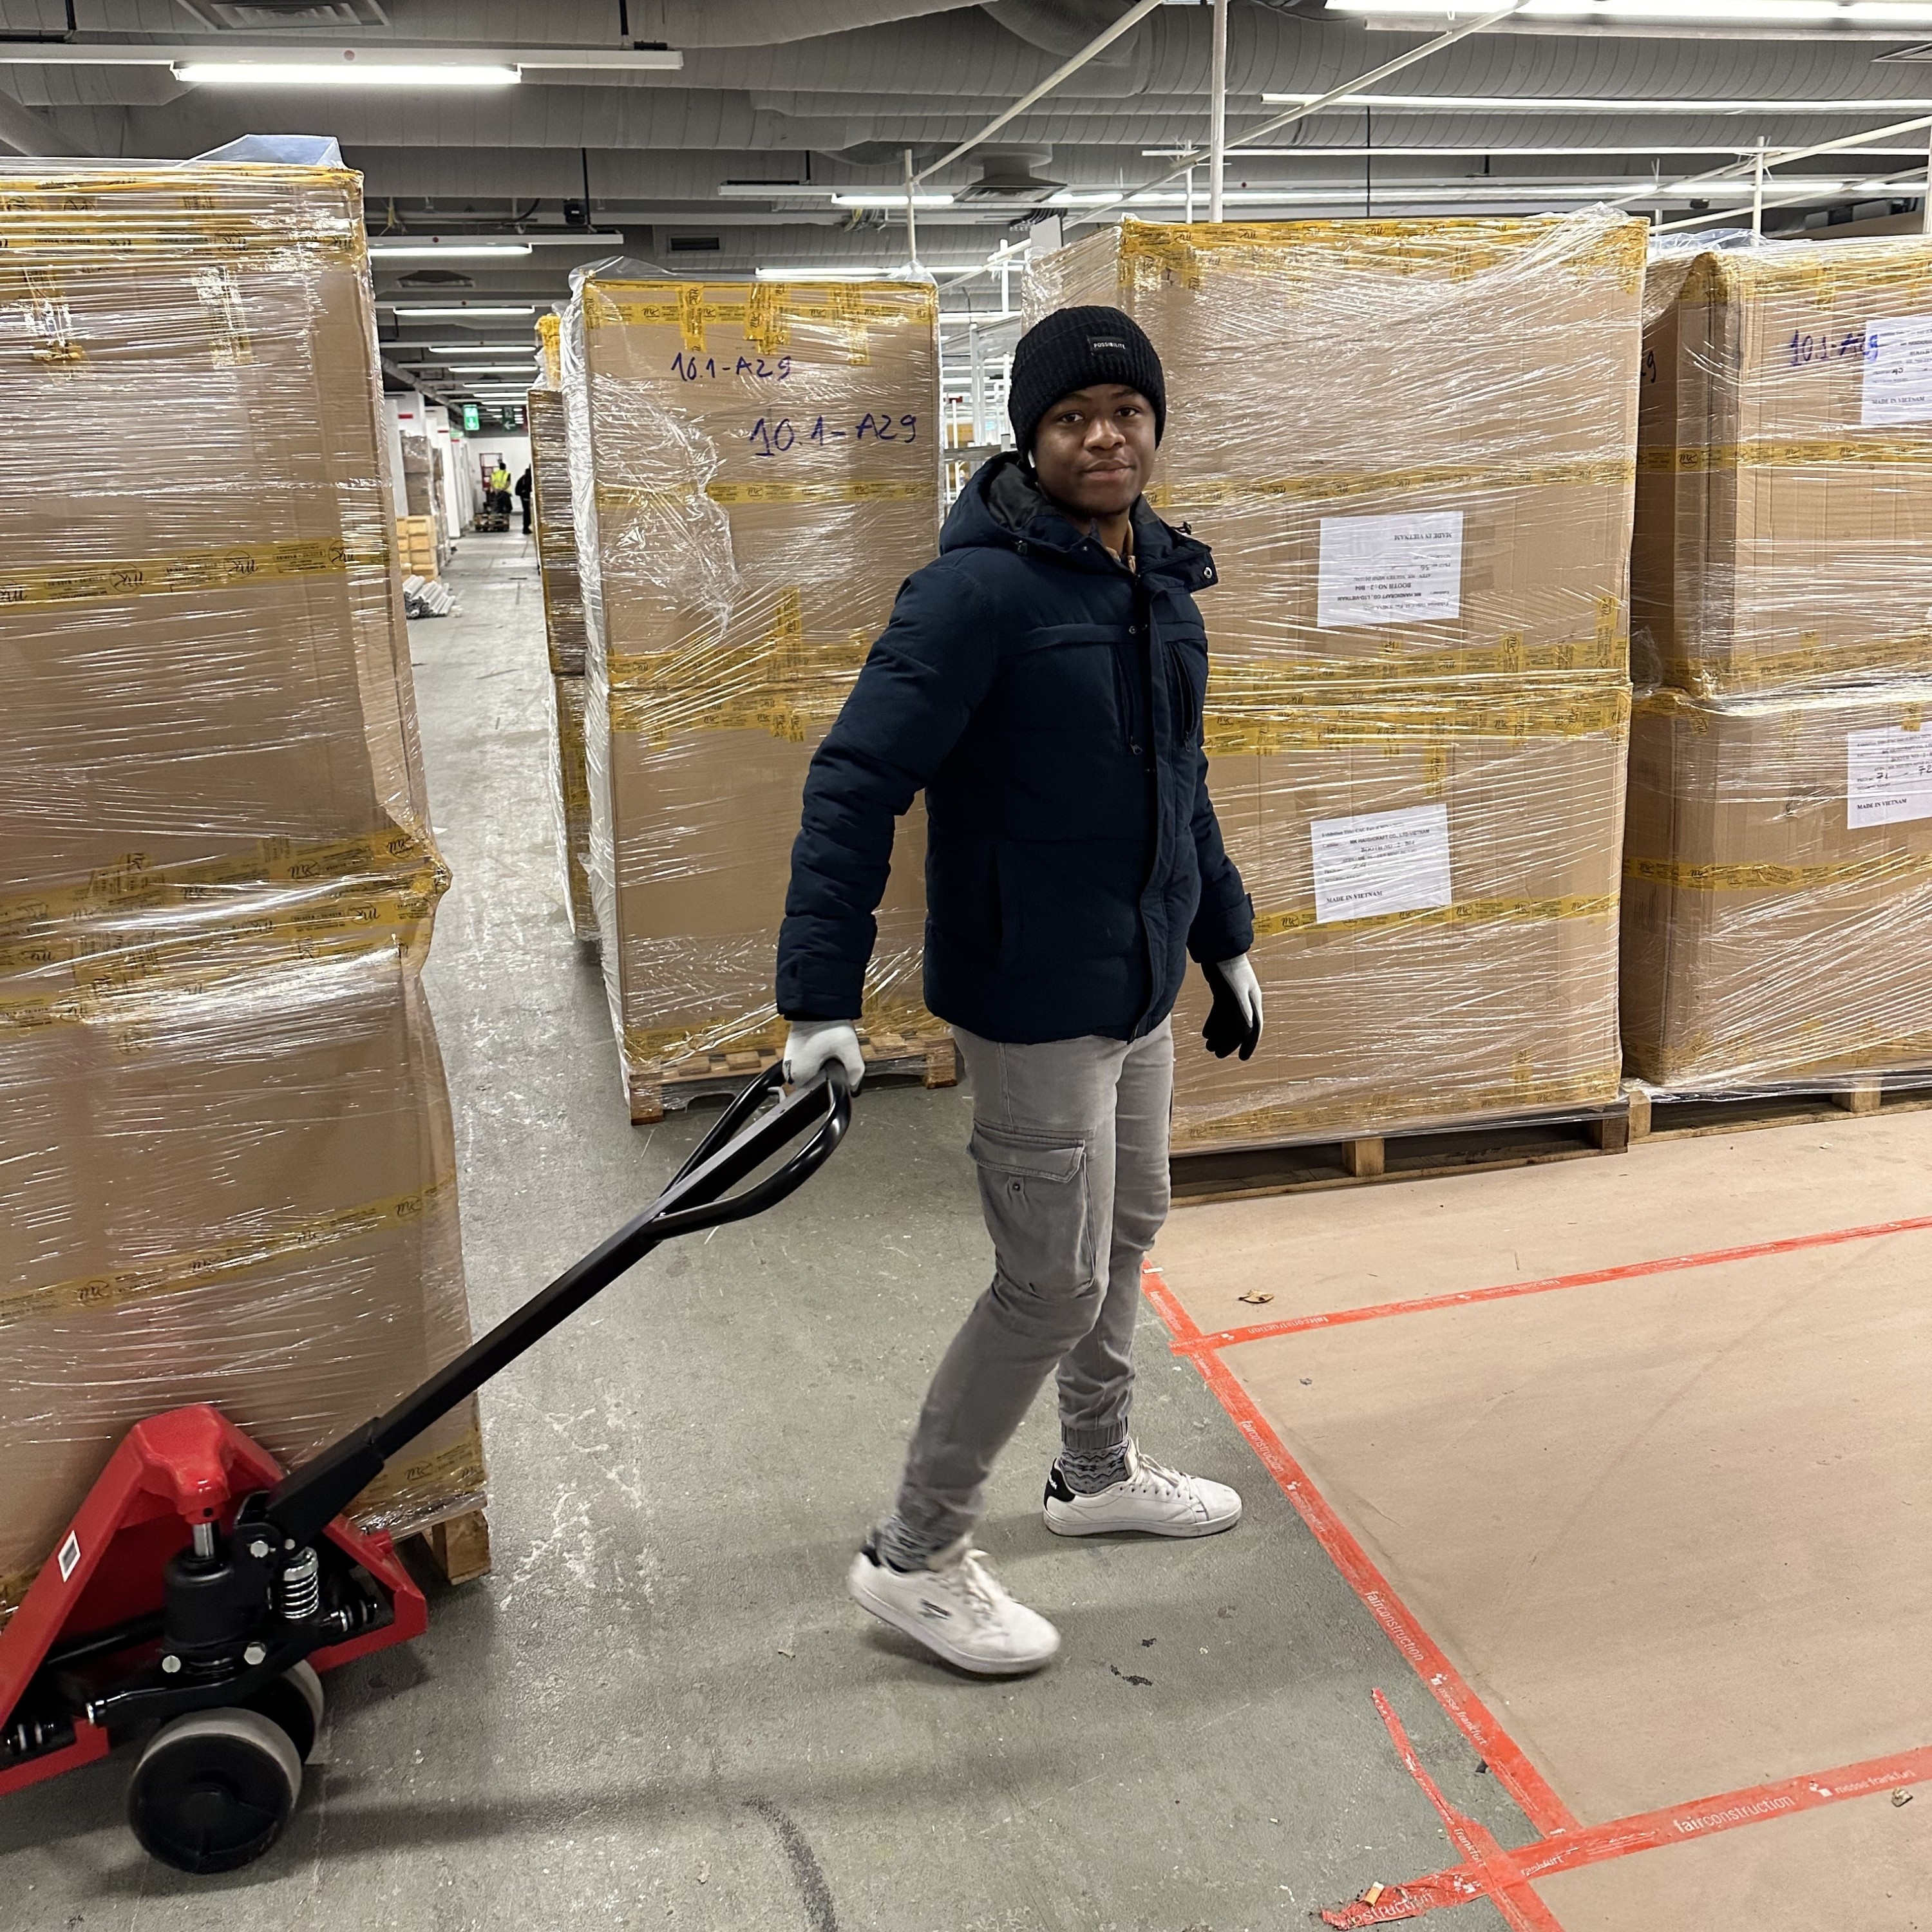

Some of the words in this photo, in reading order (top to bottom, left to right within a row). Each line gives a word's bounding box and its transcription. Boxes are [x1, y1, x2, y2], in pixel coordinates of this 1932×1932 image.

[1327, 893, 1345, 902] MADE
[1354, 891, 1383, 900] VIETNAM
[1247, 1316, 1329, 1335] fairconstruction
[1239, 1420, 1284, 1473] fairconstruction
[1365, 1590, 1425, 1662] fairconstruction
[1438, 1687, 1460, 1710] messe
[1457, 1711, 1488, 1746] frankfurt
[1868, 1769, 1917, 1786] frankfurt
[1673, 1794, 1795, 1834] fairconstruction
